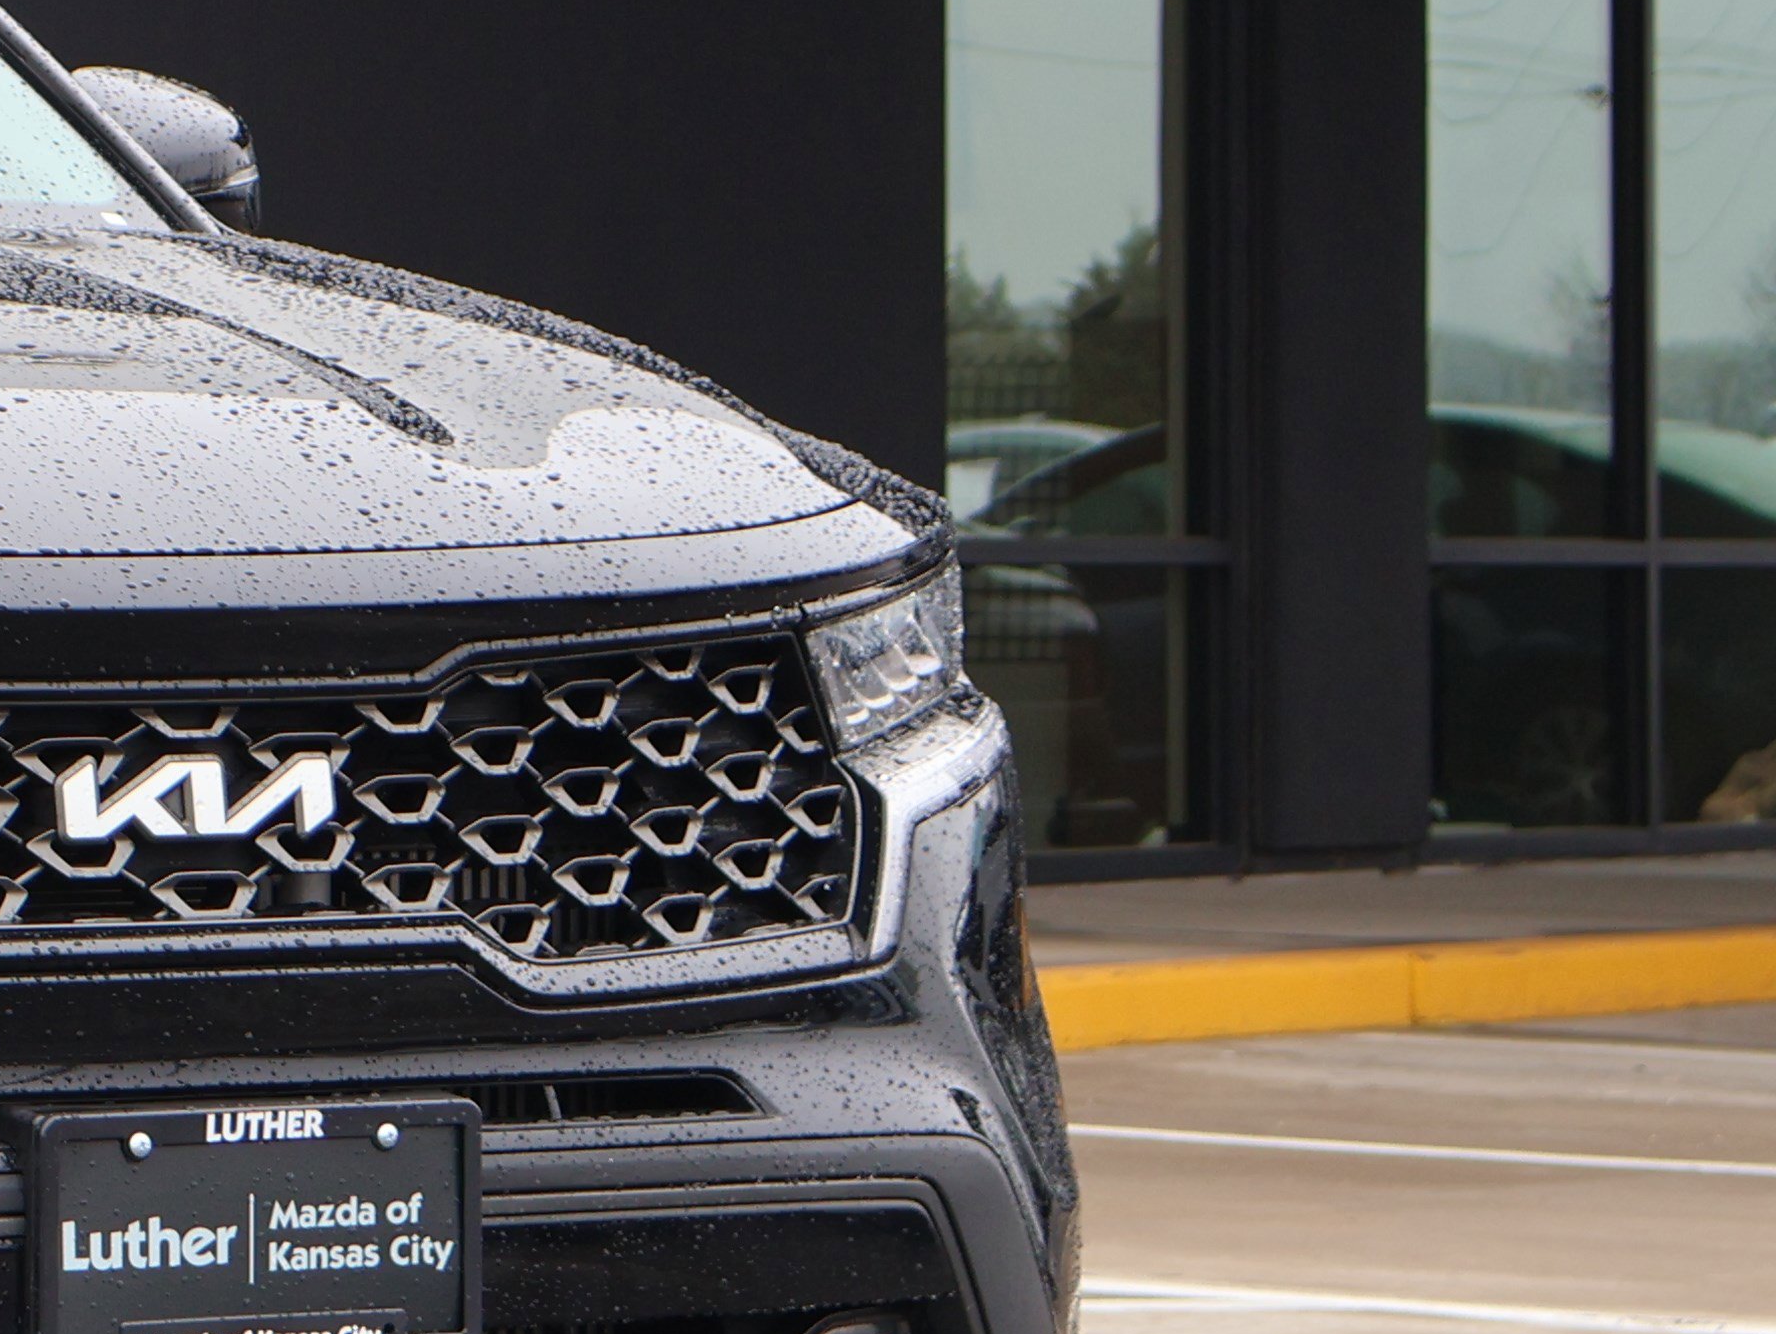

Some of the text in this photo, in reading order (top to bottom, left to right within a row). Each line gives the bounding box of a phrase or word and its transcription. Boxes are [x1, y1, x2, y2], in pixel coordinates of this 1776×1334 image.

[54, 752, 338, 840] KIA
[204, 1108, 325, 1143] LUTHER
[268, 1192, 424, 1230] Mazda of
[60, 1215, 239, 1272] Luther
[268, 1235, 454, 1272] Kansas City
